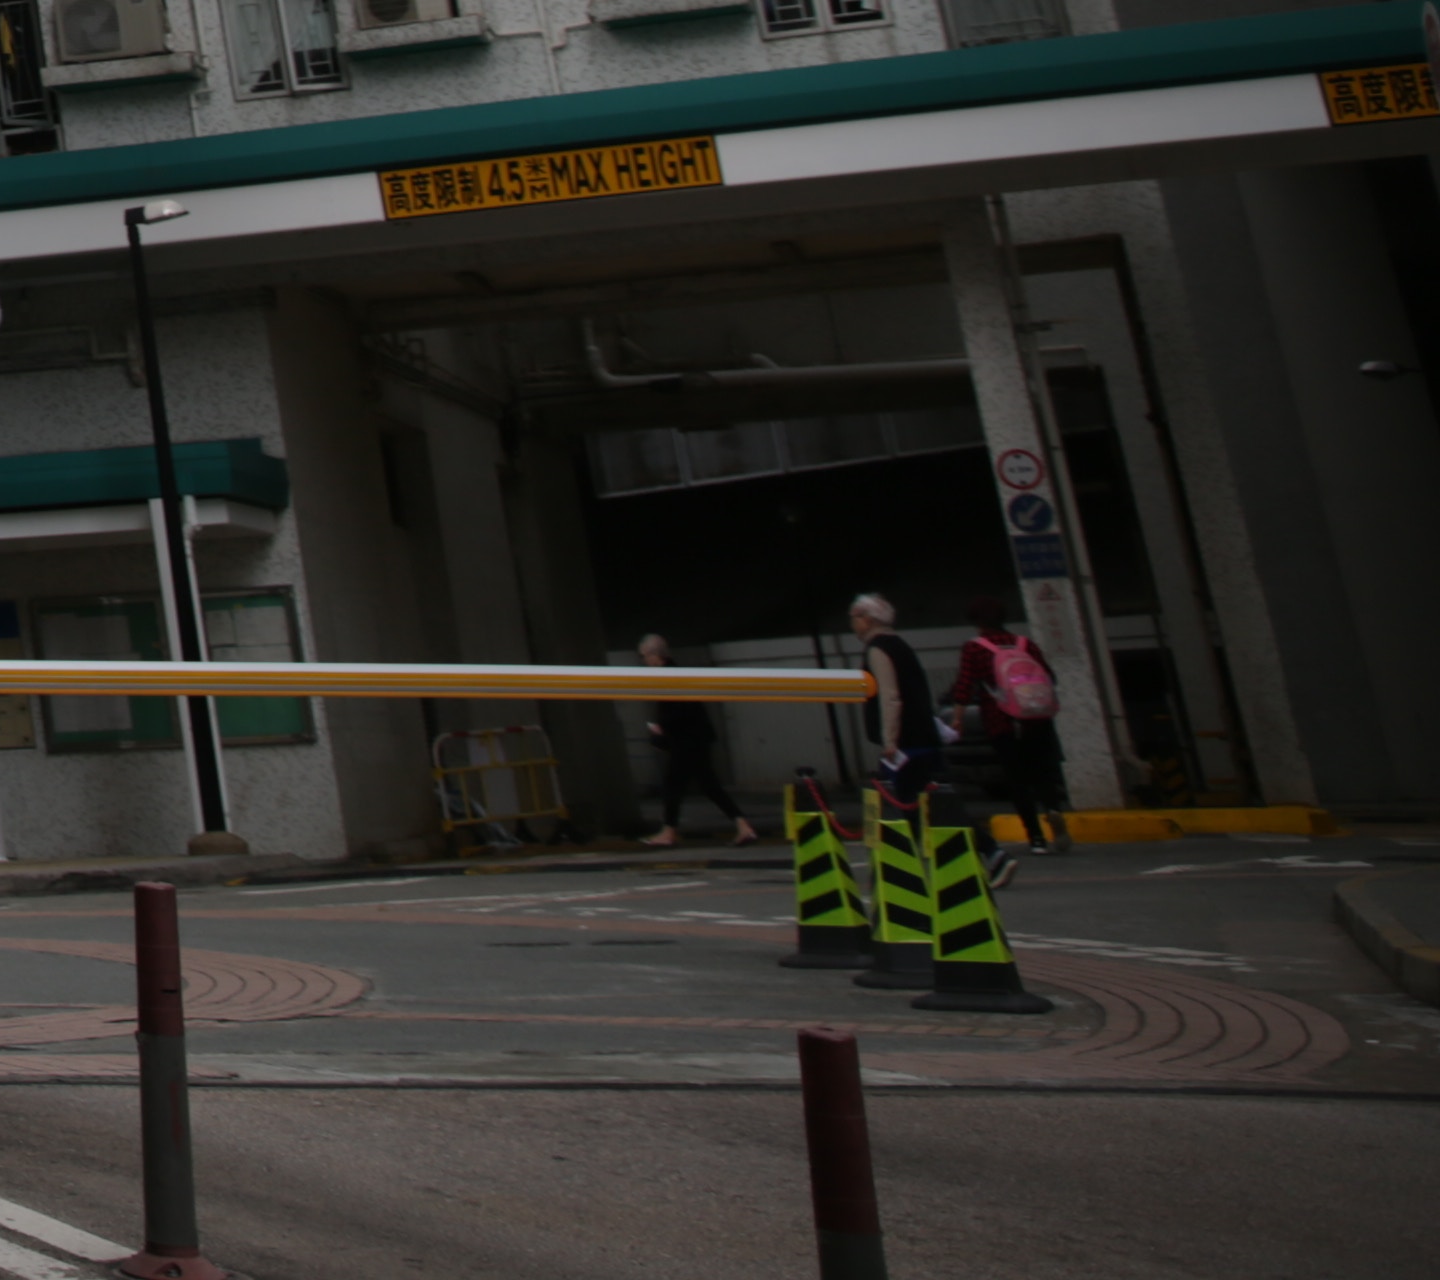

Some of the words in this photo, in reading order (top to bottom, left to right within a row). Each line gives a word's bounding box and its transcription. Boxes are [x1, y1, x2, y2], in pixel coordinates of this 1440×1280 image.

[384, 165, 484, 215] 高度限制
[488, 160, 526, 203] 4.5
[549, 150, 611, 197] MAX
[612, 140, 714, 190] HEIGHT
